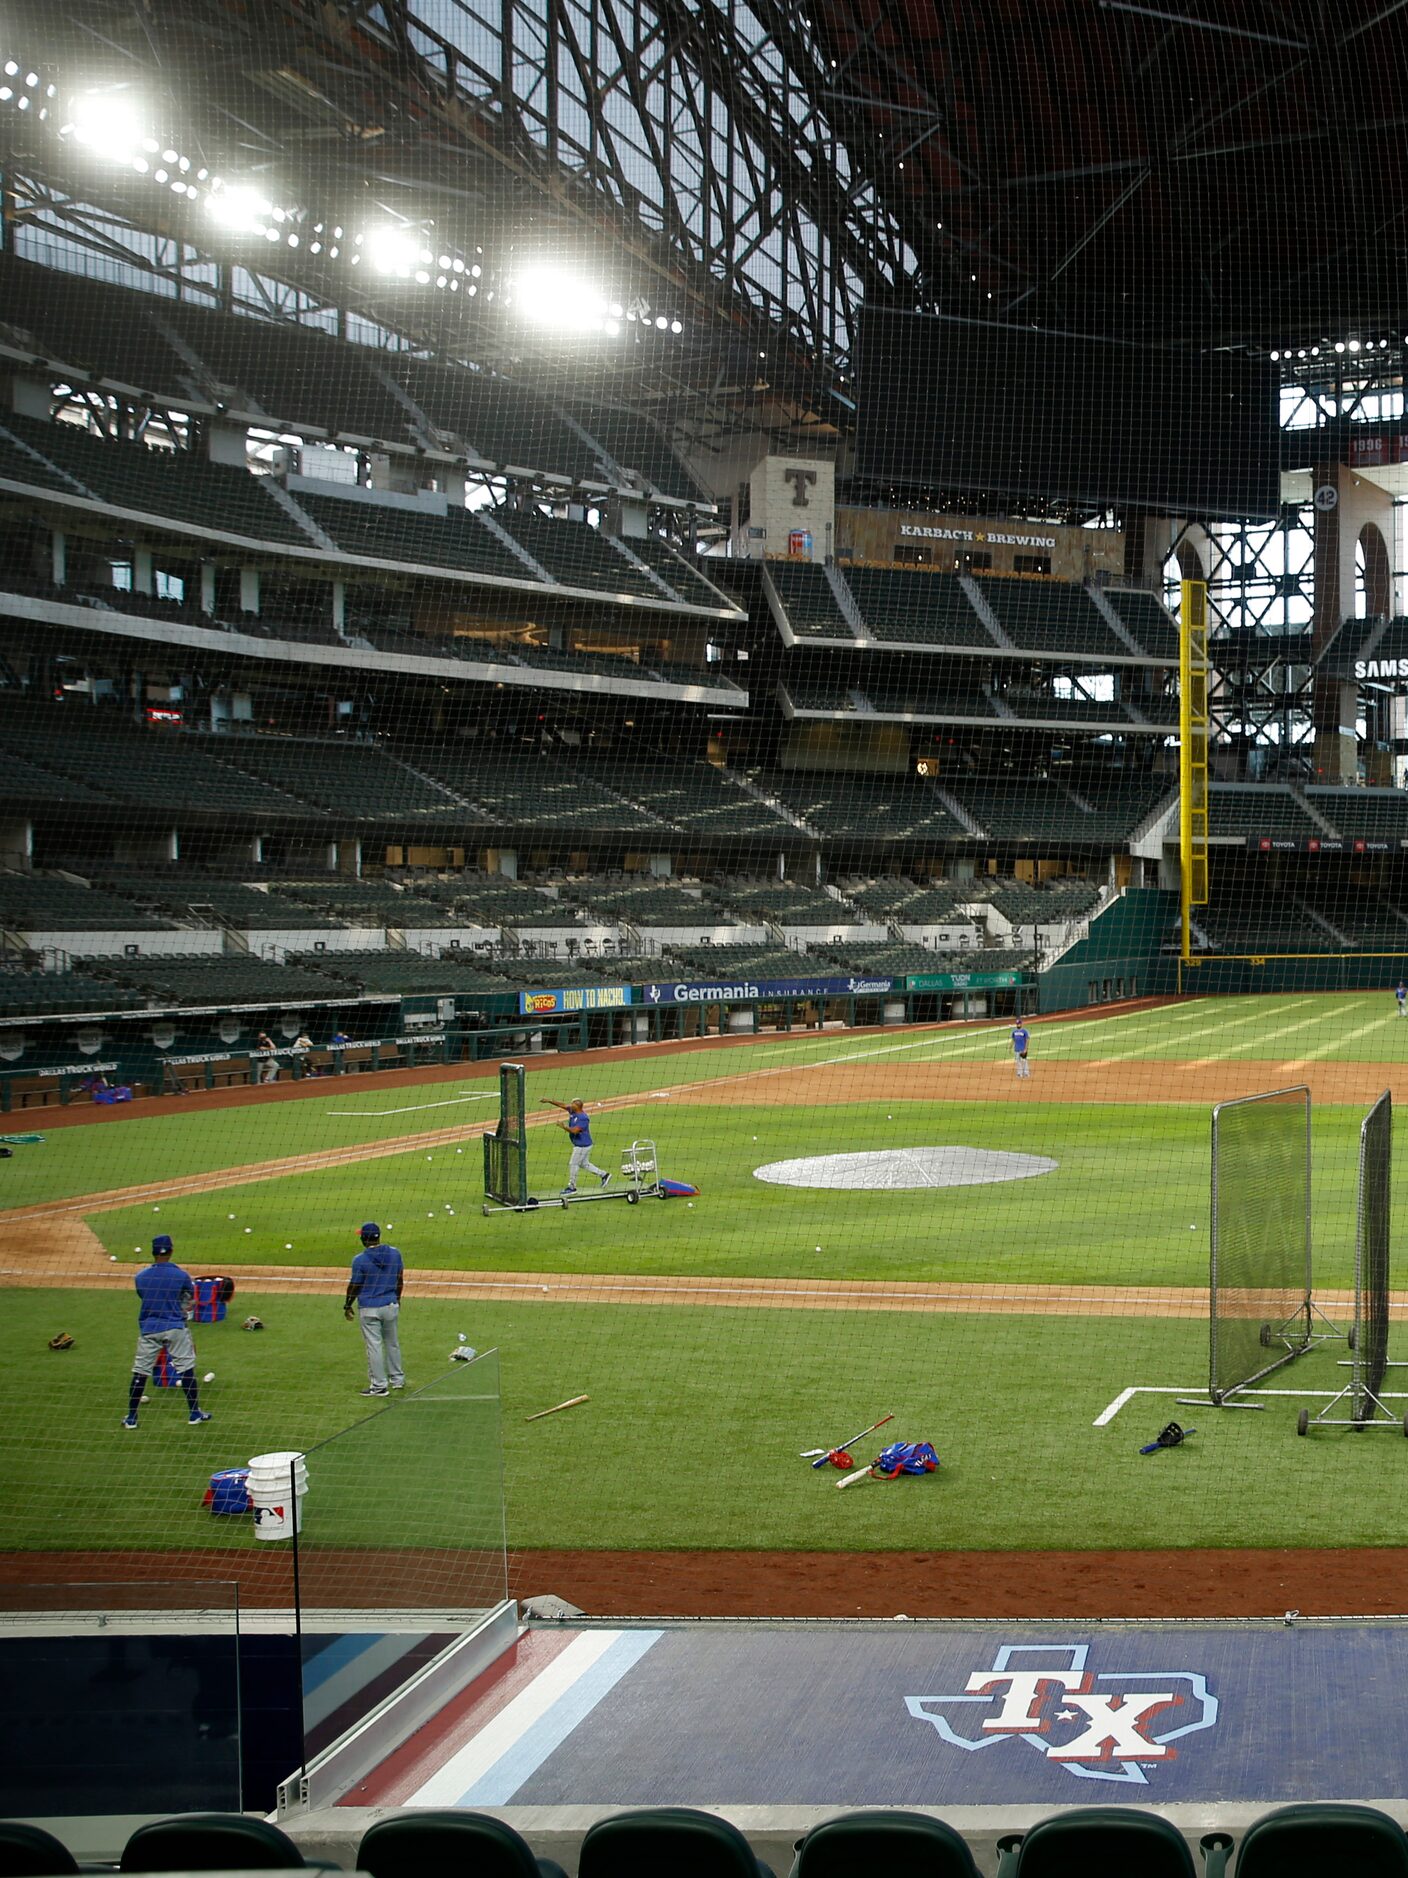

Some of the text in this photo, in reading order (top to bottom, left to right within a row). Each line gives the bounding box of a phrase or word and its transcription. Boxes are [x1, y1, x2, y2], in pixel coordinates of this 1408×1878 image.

[1352, 438, 1383, 452] 1996
[785, 469, 817, 506] T
[1316, 490, 1337, 506] 42
[900, 524, 1056, 548] KARBACH BREWING
[860, 979, 891, 989] Germania
[919, 979, 943, 988] DALLAS
[563, 987, 626, 1009] HOW TO NACHO.
[674, 982, 829, 1001] Germania INSURANCE
[186, 1055, 210, 1064] TRUCK
[210, 1053, 231, 1062] WORLD
[39, 1063, 118, 1077] DALLAS TRUCK WORLD
